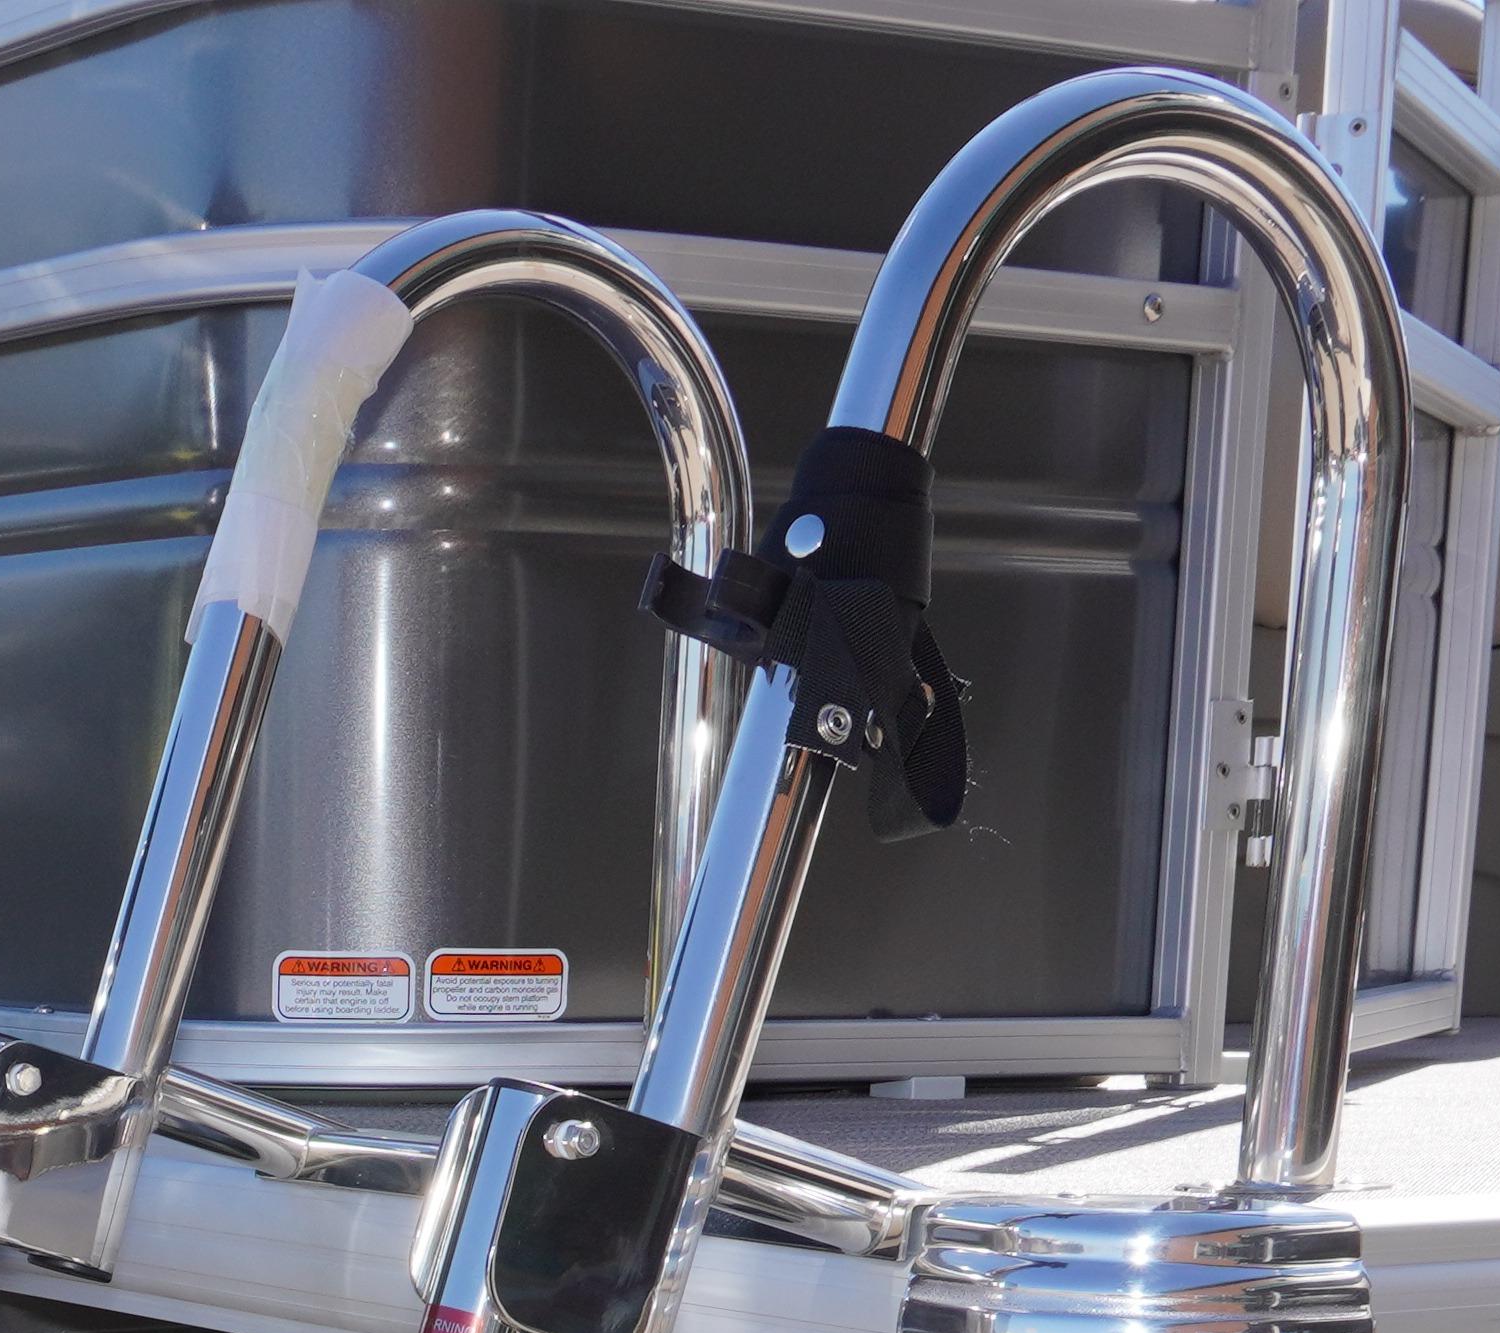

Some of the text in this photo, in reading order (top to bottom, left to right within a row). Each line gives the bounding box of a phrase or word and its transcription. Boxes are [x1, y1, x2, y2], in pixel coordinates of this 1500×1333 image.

[307, 962, 377, 973] WARNING
[468, 960, 532, 970] WARNING
[333, 980, 373, 989] potentially
[320, 989, 336, 997] may
[340, 998, 367, 1006] engine
[379, 997, 389, 1005] off
[312, 1007, 333, 1015] using
[336, 1006, 371, 1015] boarding
[478, 1004, 503, 1012] engine
